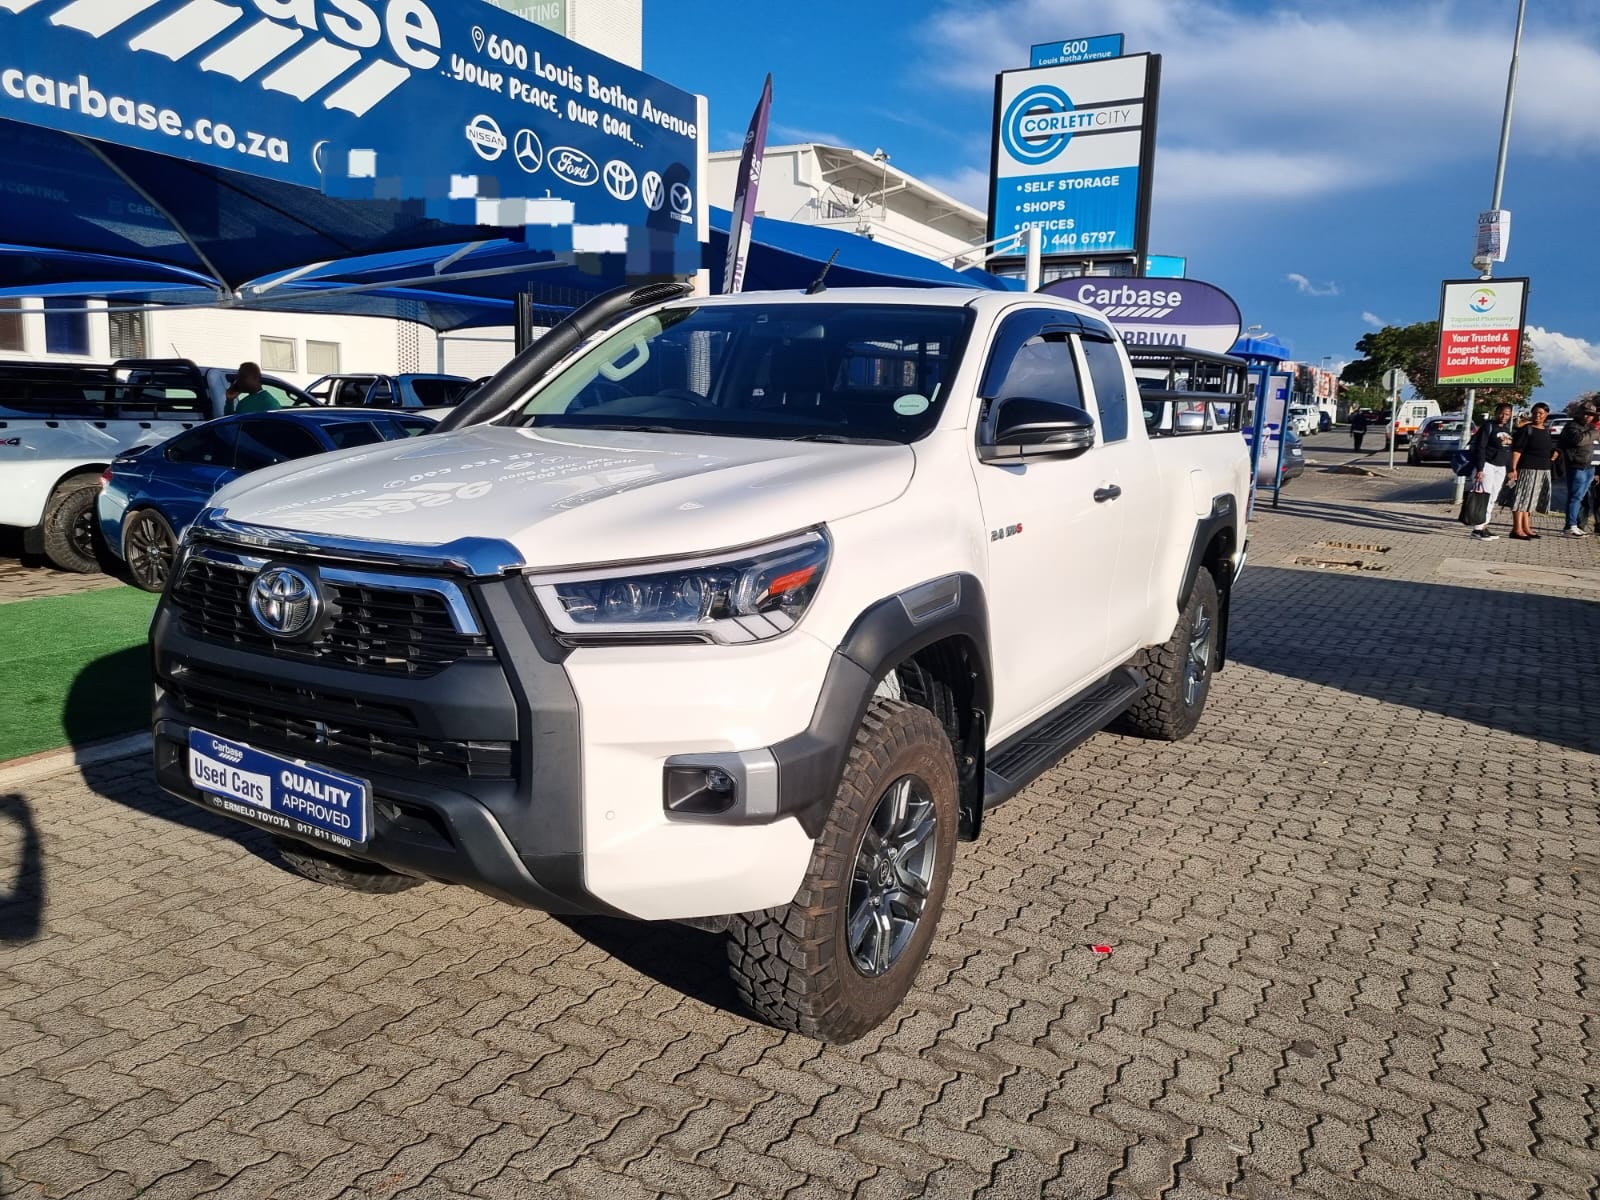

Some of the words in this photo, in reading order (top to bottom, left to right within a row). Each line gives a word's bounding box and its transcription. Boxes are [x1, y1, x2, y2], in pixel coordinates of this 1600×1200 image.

[1062, 40, 1088, 55] 600
[1038, 56, 1058, 66] Louis
[1059, 54, 1082, 63] Botha
[1083, 51, 1112, 60] Avenue
[487, 34, 528, 70] 600
[534, 51, 583, 93] Louis
[587, 74, 638, 116] Botha
[641, 98, 697, 140] Avenue
[509, 76, 563, 119] PEACE,
[567, 99, 599, 128] OUR
[1, 68, 290, 164] carbase.co.za
[468, 128, 505, 147] NISSAN
[556, 151, 590, 180] Ford
[1023, 178, 1055, 193] SELF
[1058, 175, 1120, 190] STORAGE
[1023, 200, 1066, 213] SHOPS
[1051, 233, 1077, 245] 440
[1080, 231, 1116, 244] 6797
[1077, 284, 1183, 307] Carbase
[1452, 333, 1470, 343] Your
[1471, 333, 1501, 342] Trusted
[1501, 332, 1509, 342] &
[1447, 345, 1479, 355] Longest
[1480, 344, 1511, 355] Serving
[1447, 356, 1468, 366] Local
[1469, 356, 1510, 367] Pharmacy
[212, 739, 244, 760] Carbase
[194, 757, 227, 788] Used
[231, 771, 264, 802] Cars
[281, 770, 351, 808] QUALITY
[223, 800, 256, 818] ERMELO
[256, 811, 290, 829] TOYOTA
[297, 822, 312, 834] 017
[314, 828, 329, 840] 811
[282, 793, 351, 829] APPROVED
